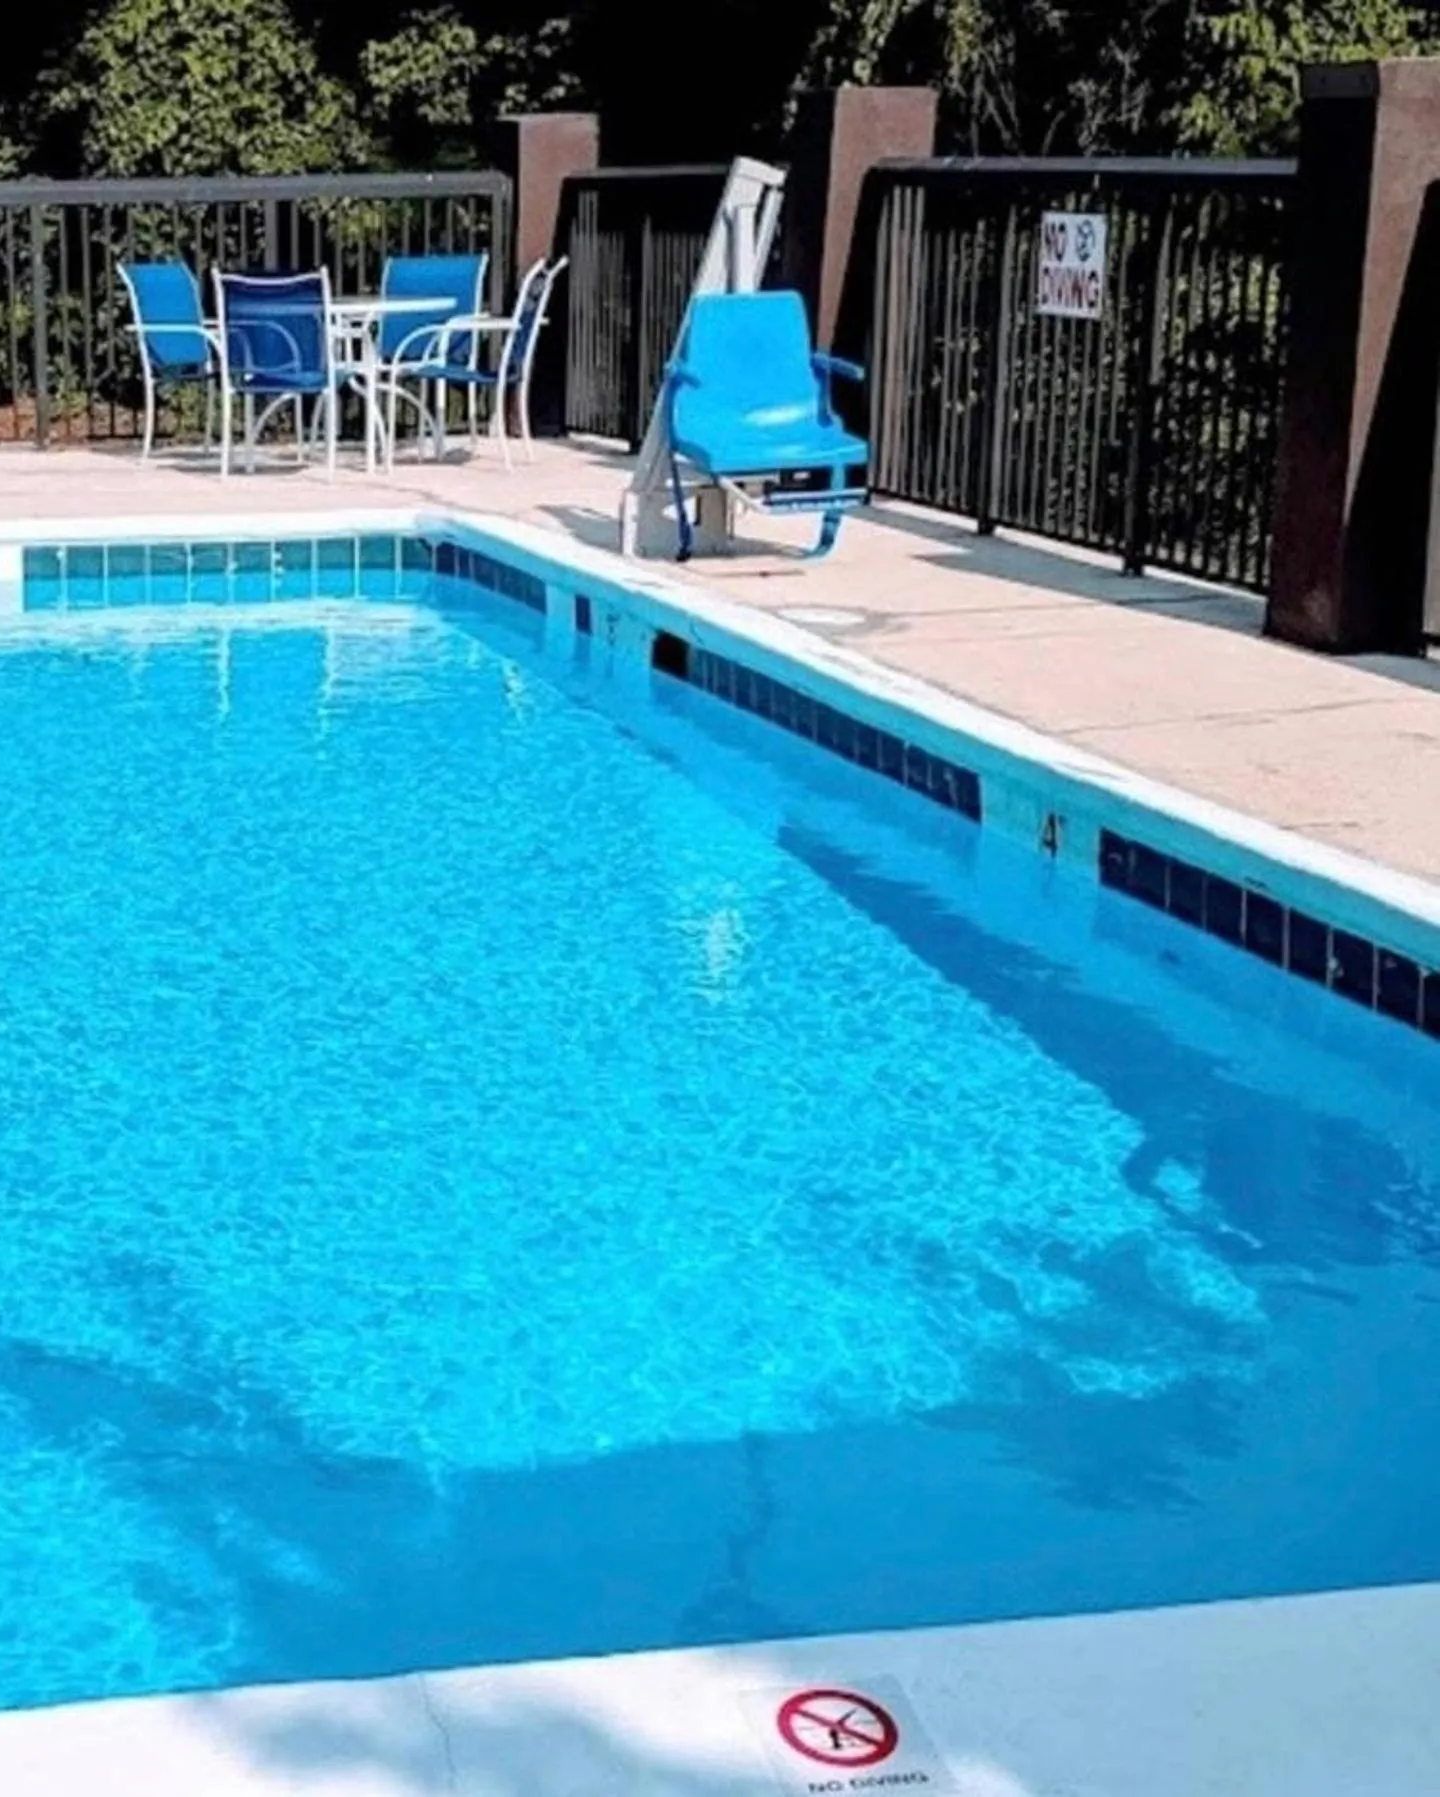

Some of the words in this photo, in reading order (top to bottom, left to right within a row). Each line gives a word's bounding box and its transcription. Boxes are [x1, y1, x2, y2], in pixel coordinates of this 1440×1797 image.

[1043, 221, 1067, 262] NO
[1041, 265, 1100, 309] DIVING
[807, 1779, 845, 1793] NO
[849, 1771, 929, 1788] DIVING
